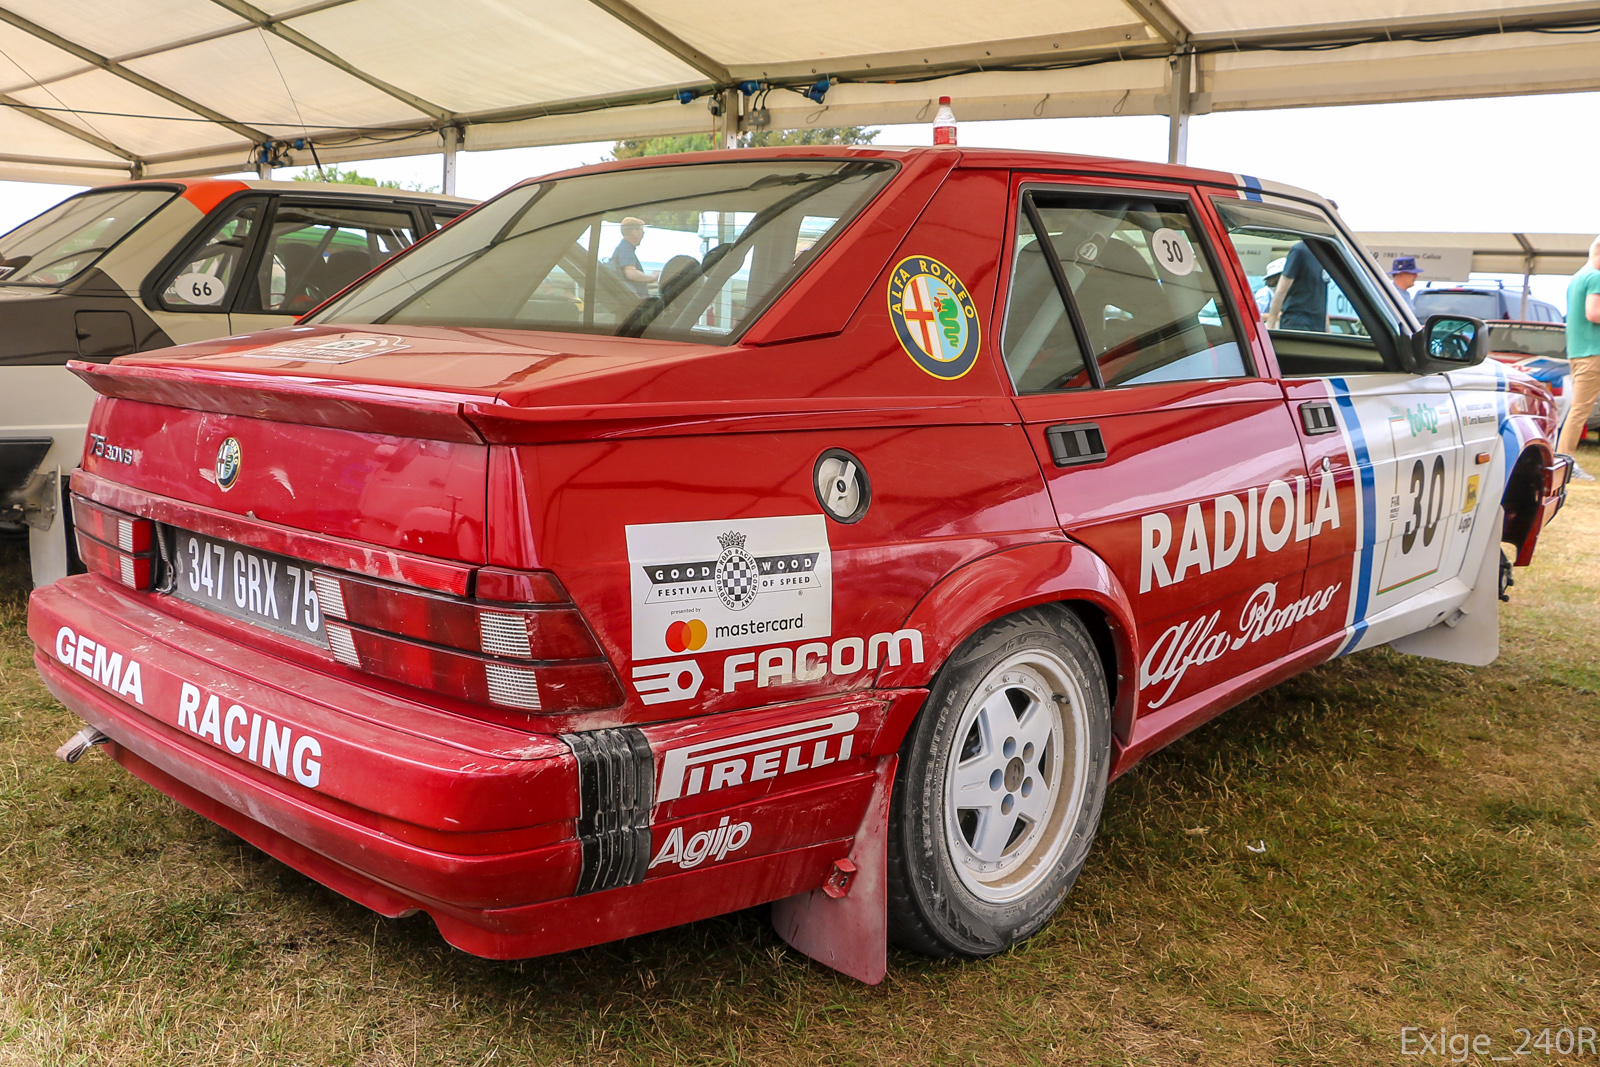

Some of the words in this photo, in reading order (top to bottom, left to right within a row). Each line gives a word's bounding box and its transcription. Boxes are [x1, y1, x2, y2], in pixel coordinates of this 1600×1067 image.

[1162, 240, 1183, 262] 30
[192, 281, 212, 297] 66
[892, 268, 911, 316] ALFA
[919, 260, 975, 318] ROMEO
[1406, 403, 1438, 437] totip
[89, 433, 106, 457] 75
[1402, 455, 1445, 555] 30
[1139, 469, 1341, 594] RADIOLA
[719, 550, 732, 565] ROAD
[735, 549, 756, 570] RACING
[188, 537, 225, 600] 347
[233, 551, 280, 620] GRX
[287, 565, 320, 632] 75
[658, 585, 714, 597] FESTIVAL
[762, 579, 775, 587] OF
[779, 576, 811, 586] SPEED
[741, 573, 758, 608] COMPANY
[670, 607, 694, 615] presented
[695, 606, 701, 614] by
[715, 613, 803, 638] mastercard
[723, 628, 924, 693] FACOM
[1139, 609, 1231, 709] Alfa
[1230, 581, 1342, 650] Romeo
[55, 626, 144, 705] GEMA
[177, 682, 322, 788] RACING
[656, 712, 860, 803] PIRELLI
[648, 816, 752, 868] Agip
